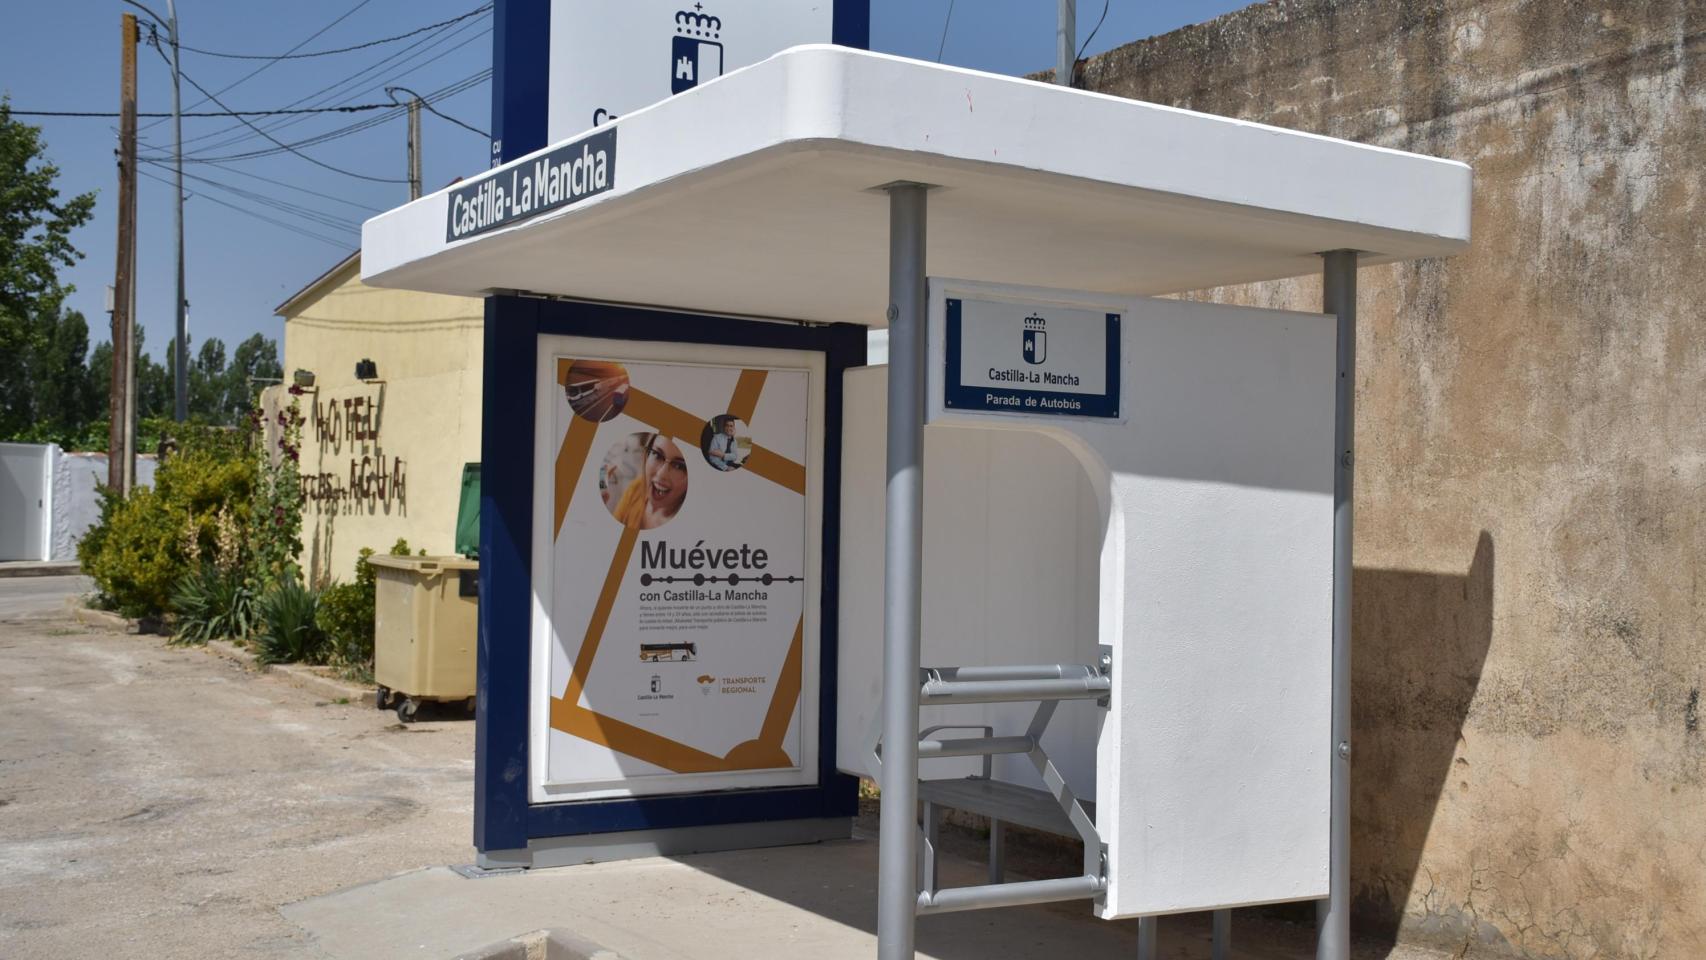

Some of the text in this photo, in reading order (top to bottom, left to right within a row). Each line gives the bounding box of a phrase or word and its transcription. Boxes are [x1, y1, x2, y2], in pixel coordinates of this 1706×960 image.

[453, 144, 607, 236] Castilla-La Mancha
[988, 368, 1080, 386] Castilla-La Mancha
[986, 394, 1081, 410] Parada de Autobús
[315, 396, 377, 442] HOTEL
[350, 455, 402, 500] AGUA
[641, 540, 769, 570] Muévete
[639, 589, 768, 601] con Castilla-La Mancha
[722, 676, 766, 685] TRANSPORTE
[722, 686, 757, 694] REGIONAL
